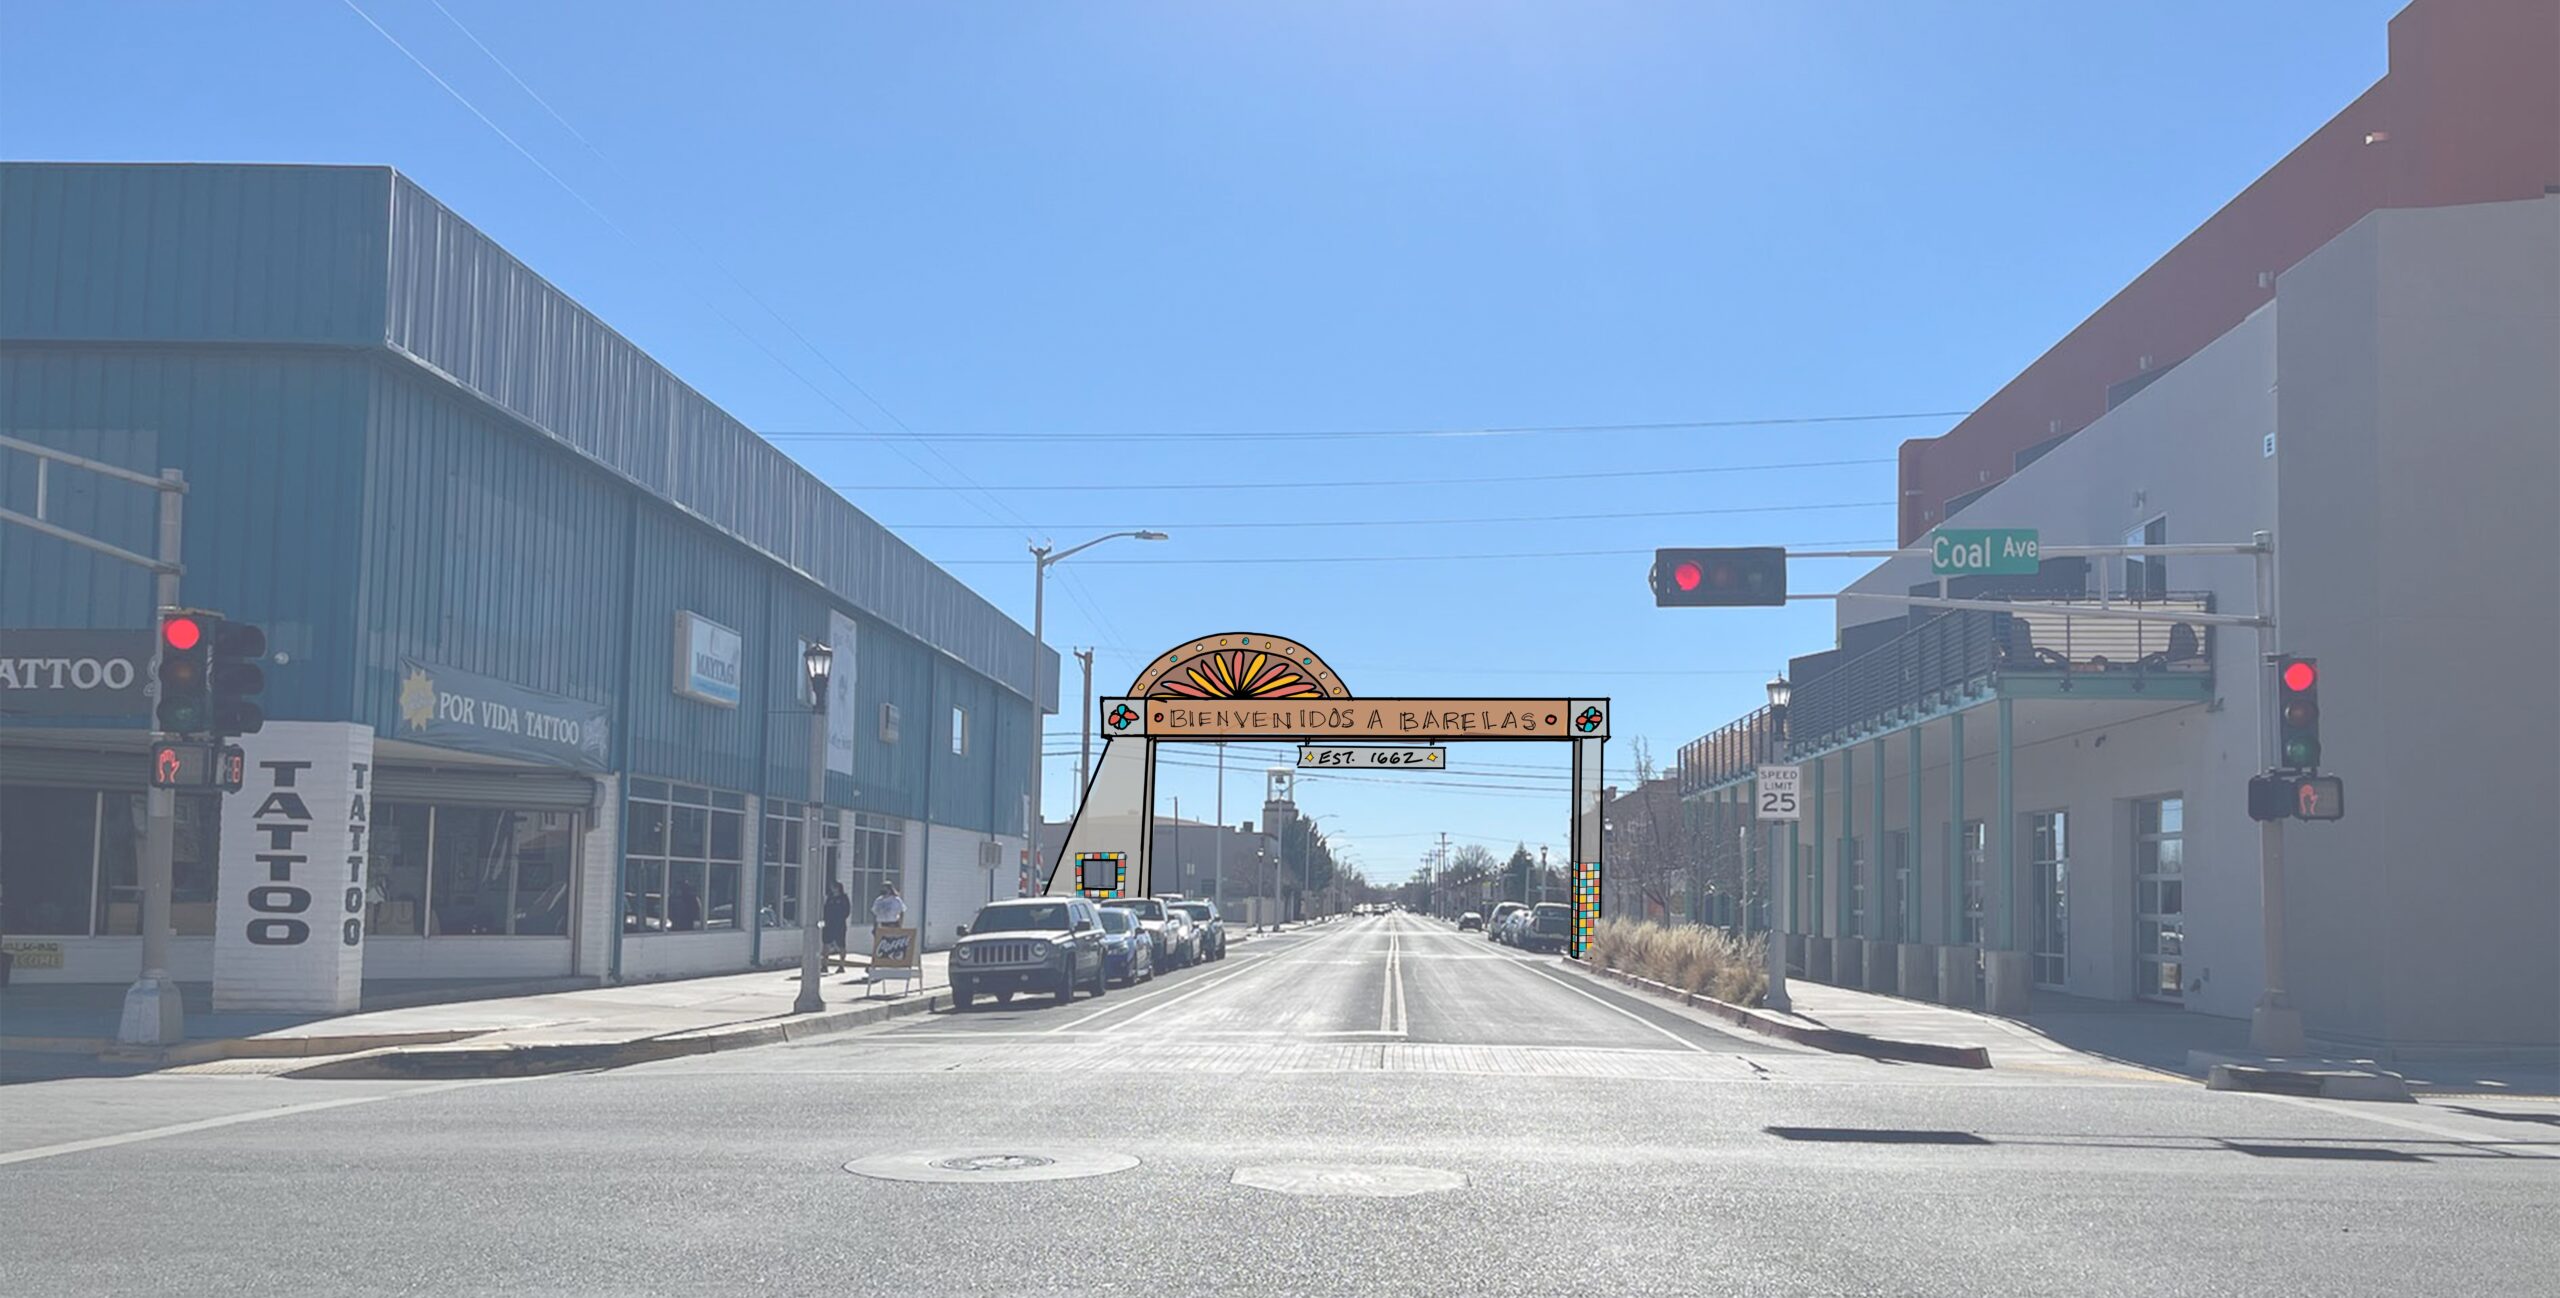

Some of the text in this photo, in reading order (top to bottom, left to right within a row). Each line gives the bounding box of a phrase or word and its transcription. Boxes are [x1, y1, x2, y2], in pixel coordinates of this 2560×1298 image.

[1933, 536, 2037, 568] Coal Ave
[0, 658, 134, 689] ATTOO
[439, 692, 579, 744] POR VIDA TATTOO
[1760, 770, 1798, 780] SPEED
[1764, 781, 1793, 790] LIMIT
[1762, 792, 1796, 812] 25
[246, 760, 313, 946] TATTOO
[343, 762, 369, 947] TATTOO
